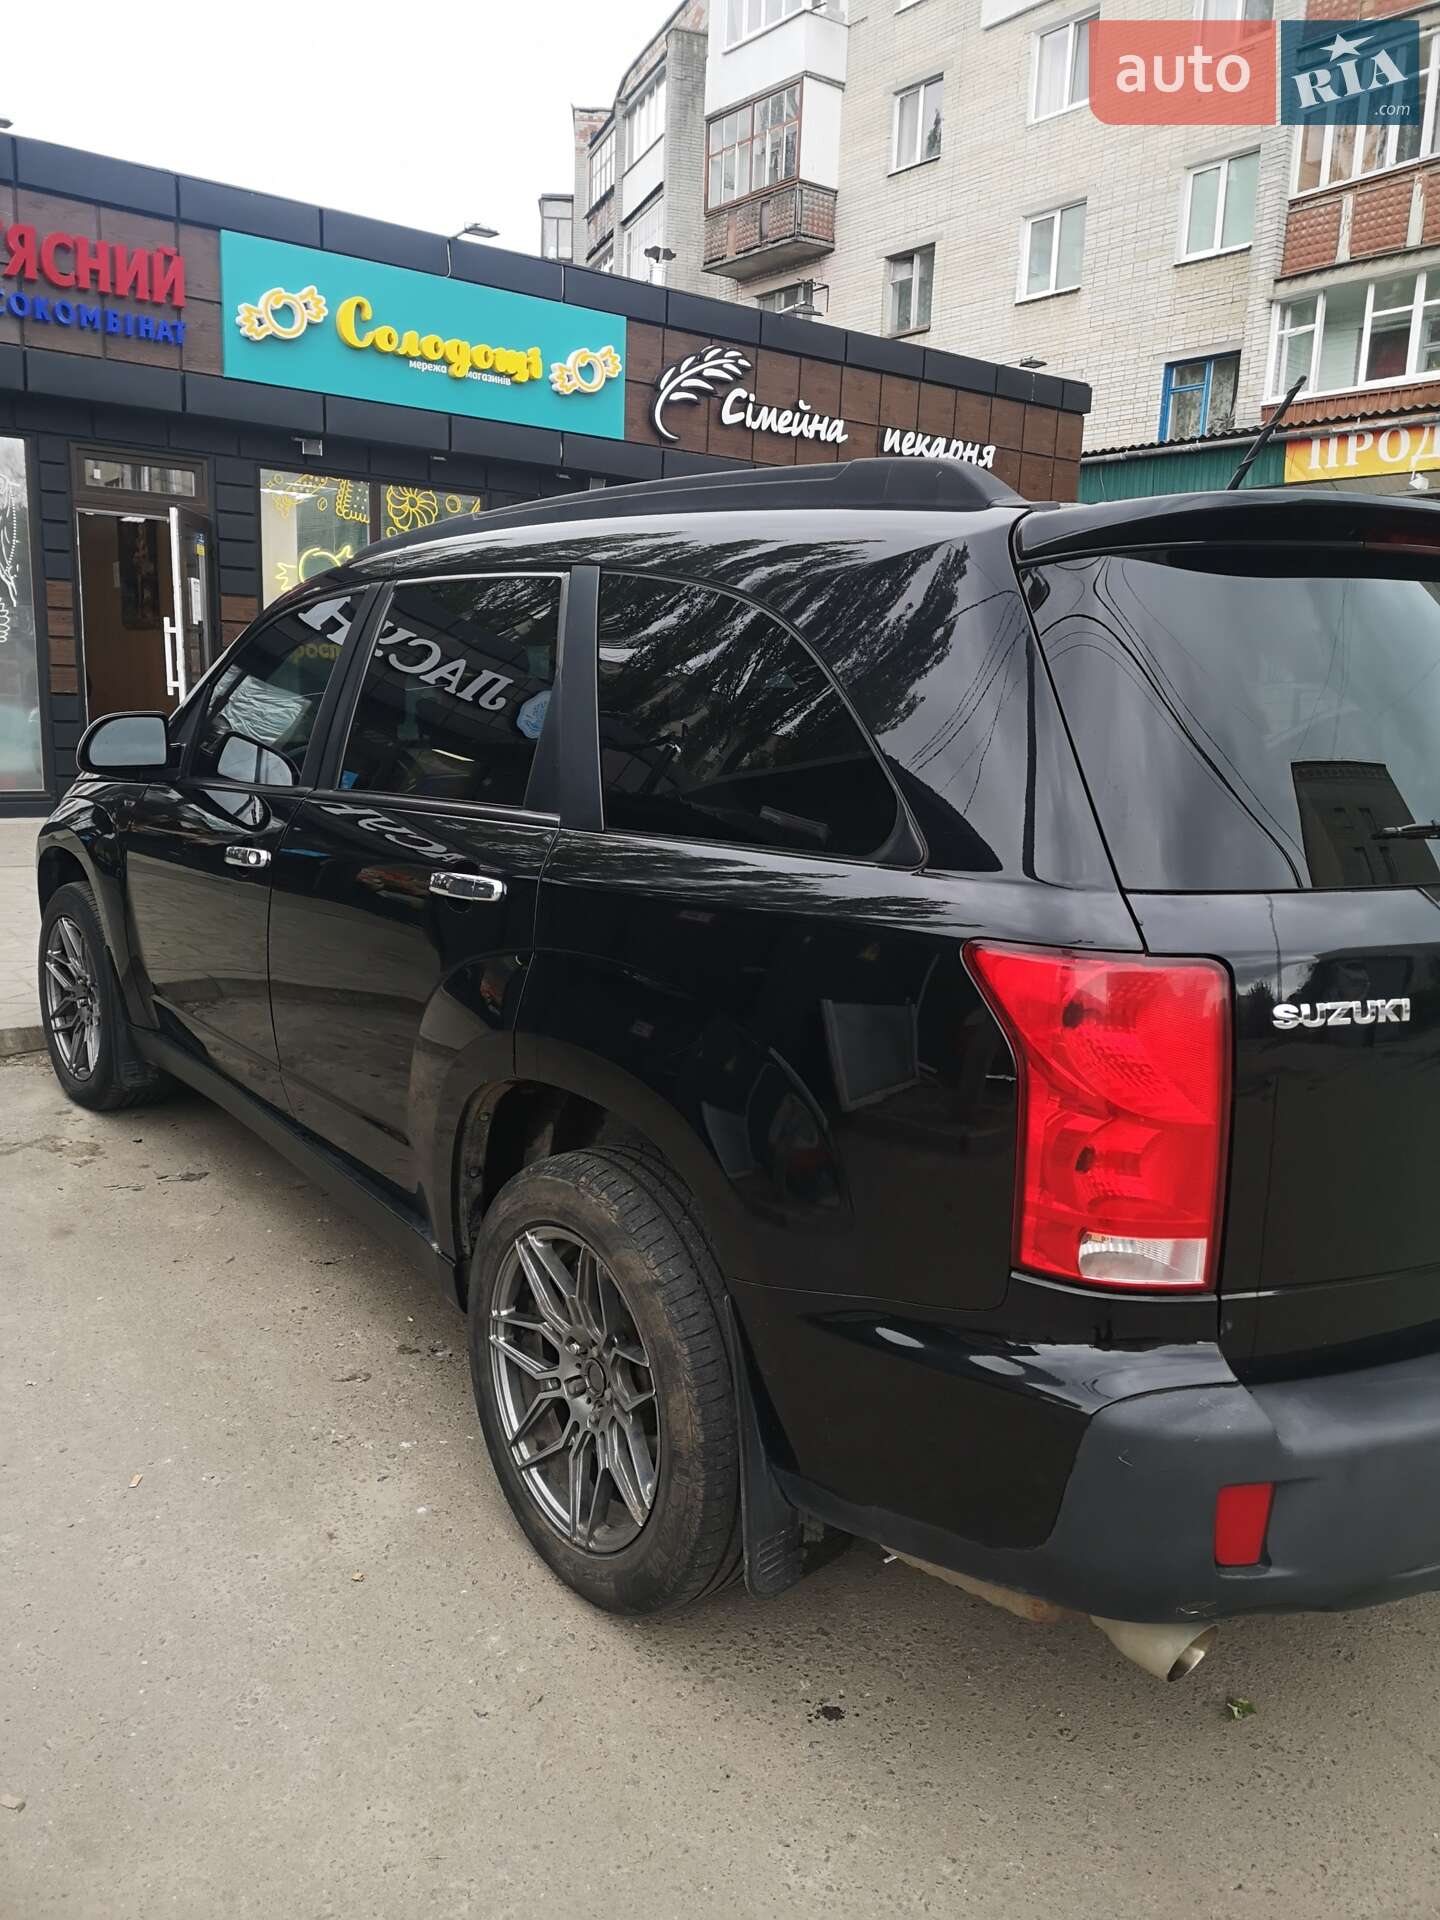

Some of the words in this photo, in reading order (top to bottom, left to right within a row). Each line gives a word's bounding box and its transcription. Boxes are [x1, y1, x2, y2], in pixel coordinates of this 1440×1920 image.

[336, 296, 543, 383] Солодощі
[409, 360, 447, 374] мережа
[465, 371, 511, 386] магазинів
[721, 387, 848, 443] Сімейна
[1272, 998, 1411, 1030] SUZUKI
